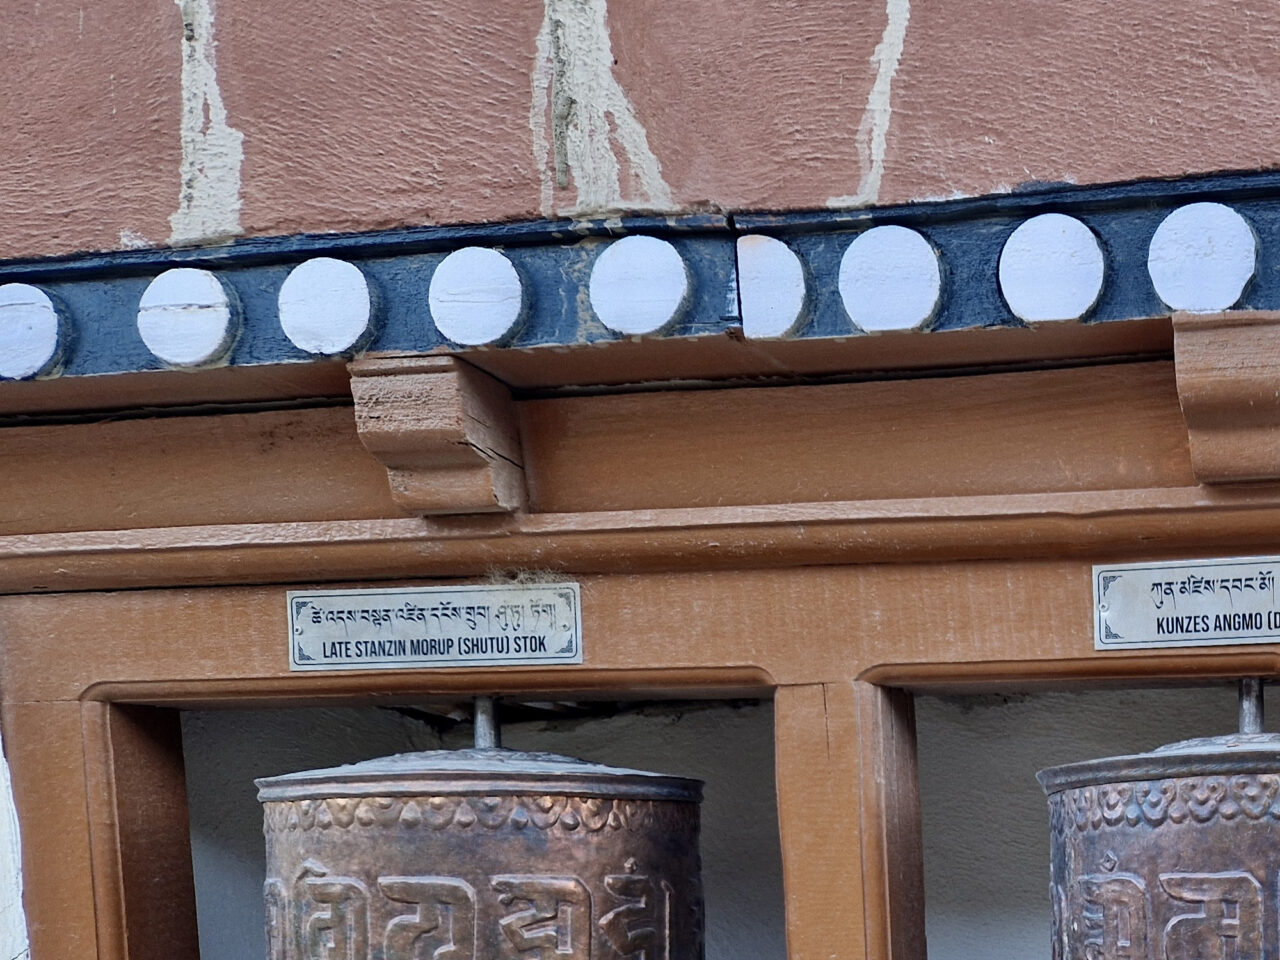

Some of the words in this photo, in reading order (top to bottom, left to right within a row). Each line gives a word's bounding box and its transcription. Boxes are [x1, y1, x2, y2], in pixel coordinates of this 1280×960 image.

[1157, 615, 1210, 634] KUNZES
[1213, 612, 1263, 631] ANGMO
[322, 641, 351, 658] LATE
[355, 639, 406, 657] STANZIN
[410, 637, 454, 656] MORUP
[458, 636, 510, 655] (SHUTU)
[514, 635, 547, 653] STOK
